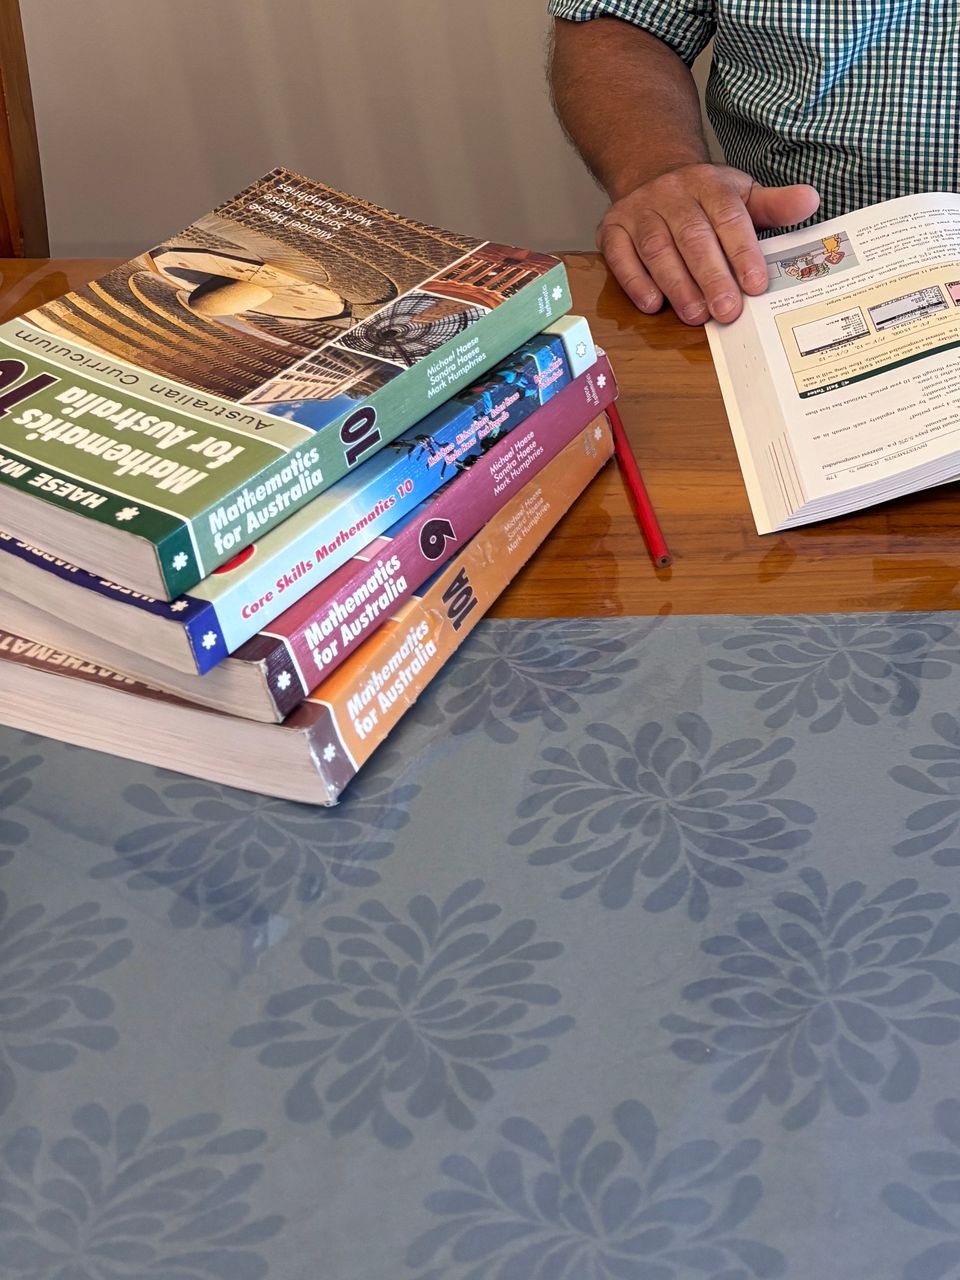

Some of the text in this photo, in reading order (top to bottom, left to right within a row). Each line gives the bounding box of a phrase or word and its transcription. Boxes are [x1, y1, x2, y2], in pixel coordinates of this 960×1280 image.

[248, 201, 334, 241] Michael Haese
[261, 192, 343, 231] Sandra Haese
[277, 182, 372, 226] Mark Humphries
[15, 329, 274, 431] Australian Curriculum
[426, 335, 478, 376] Michael Haese
[427, 351, 486, 398] Mark Humphries
[429, 345, 479, 385] Sandra Haese
[12, 405, 208, 494] Mathematics
[54, 385, 244, 468] for Australia
[339, 406, 382, 467] 10
[490, 430, 534, 474] Michael Haese
[493, 446, 544, 495] Mark Humphries
[494, 440, 537, 482] Sandra Haese
[26, 471, 107, 509] HAESE
[207, 446, 319, 534] Mathematics
[212, 468, 324, 555] for Australia
[503, 487, 542, 532] Michael Haese
[506, 501, 550, 554] Mark Humphries
[507, 497, 544, 541] Sandra Haese
[239, 478, 414, 620] Core Skills Mathematics 10
[303, 553, 401, 649] Mathematics
[313, 576, 408, 670] for Australia
[441, 566, 479, 631] 10A
[345, 621, 430, 719] Mathematics
[355, 640, 437, 739] for Australia
